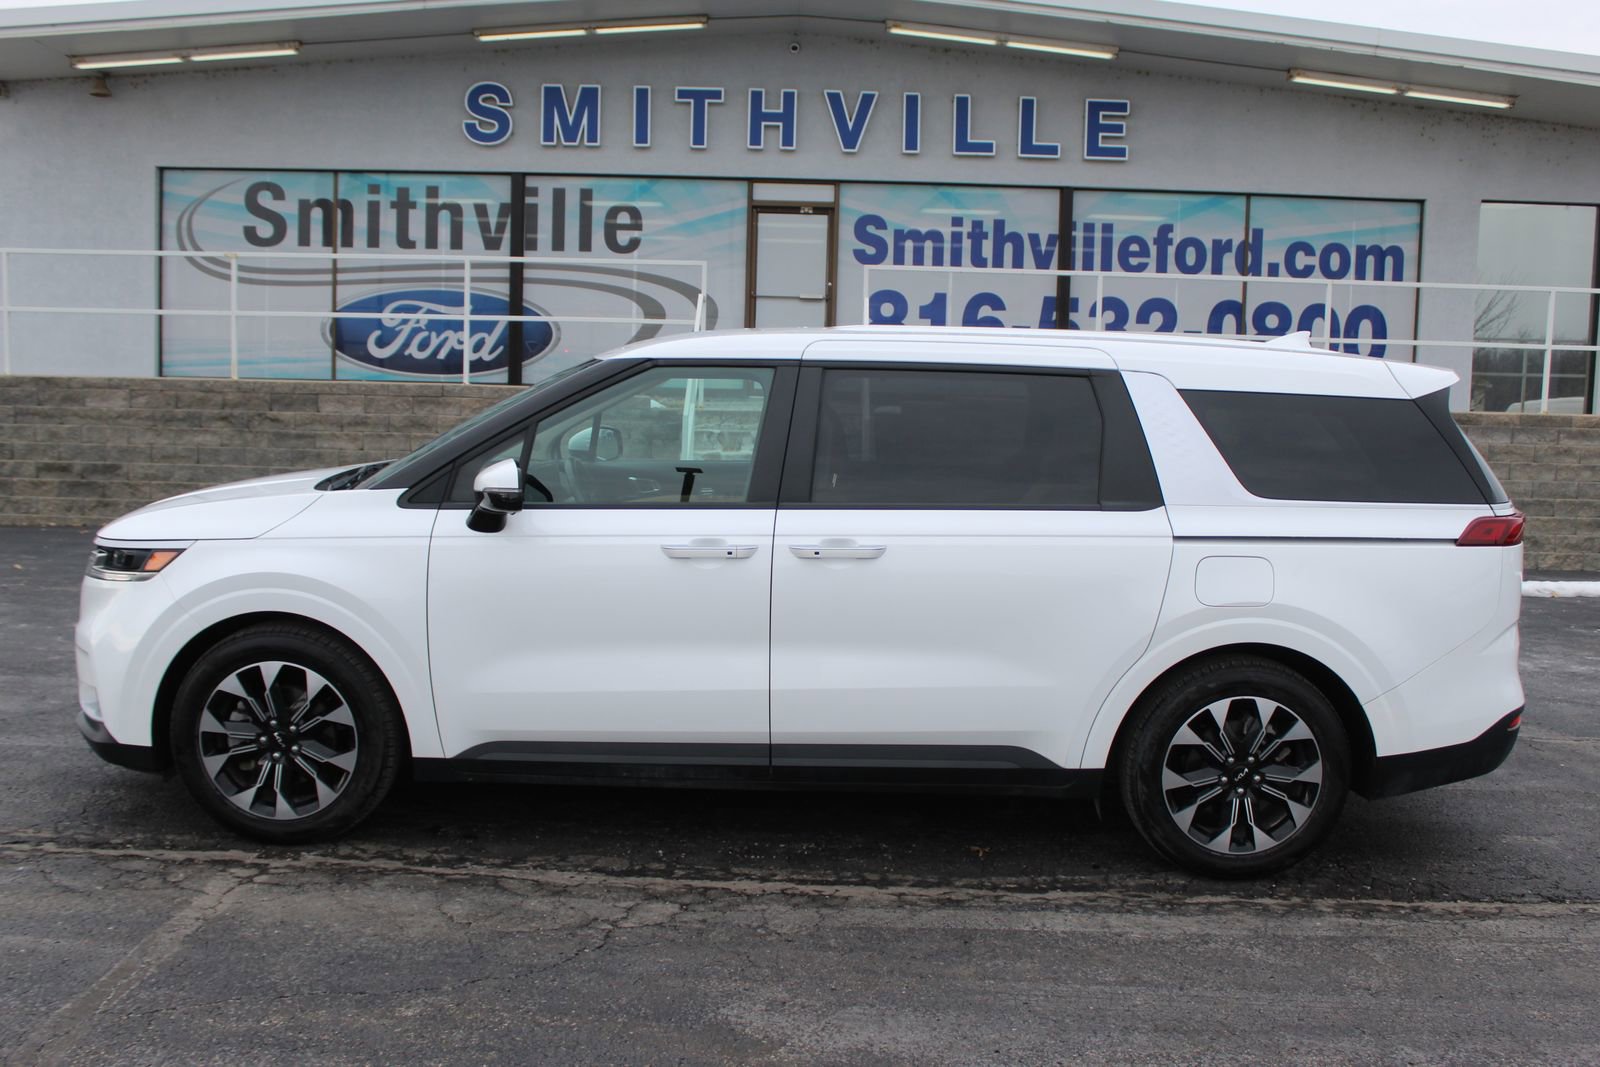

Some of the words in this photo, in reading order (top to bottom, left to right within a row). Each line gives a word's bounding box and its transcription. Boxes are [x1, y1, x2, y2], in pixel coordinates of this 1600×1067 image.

[463, 81, 1131, 161] SMITHVILLE
[243, 181, 644, 254] Smithville
[852, 214, 1405, 283] Smithvilleford.com
[367, 300, 504, 362] Ford
[869, 289, 1388, 358] 8165320800
